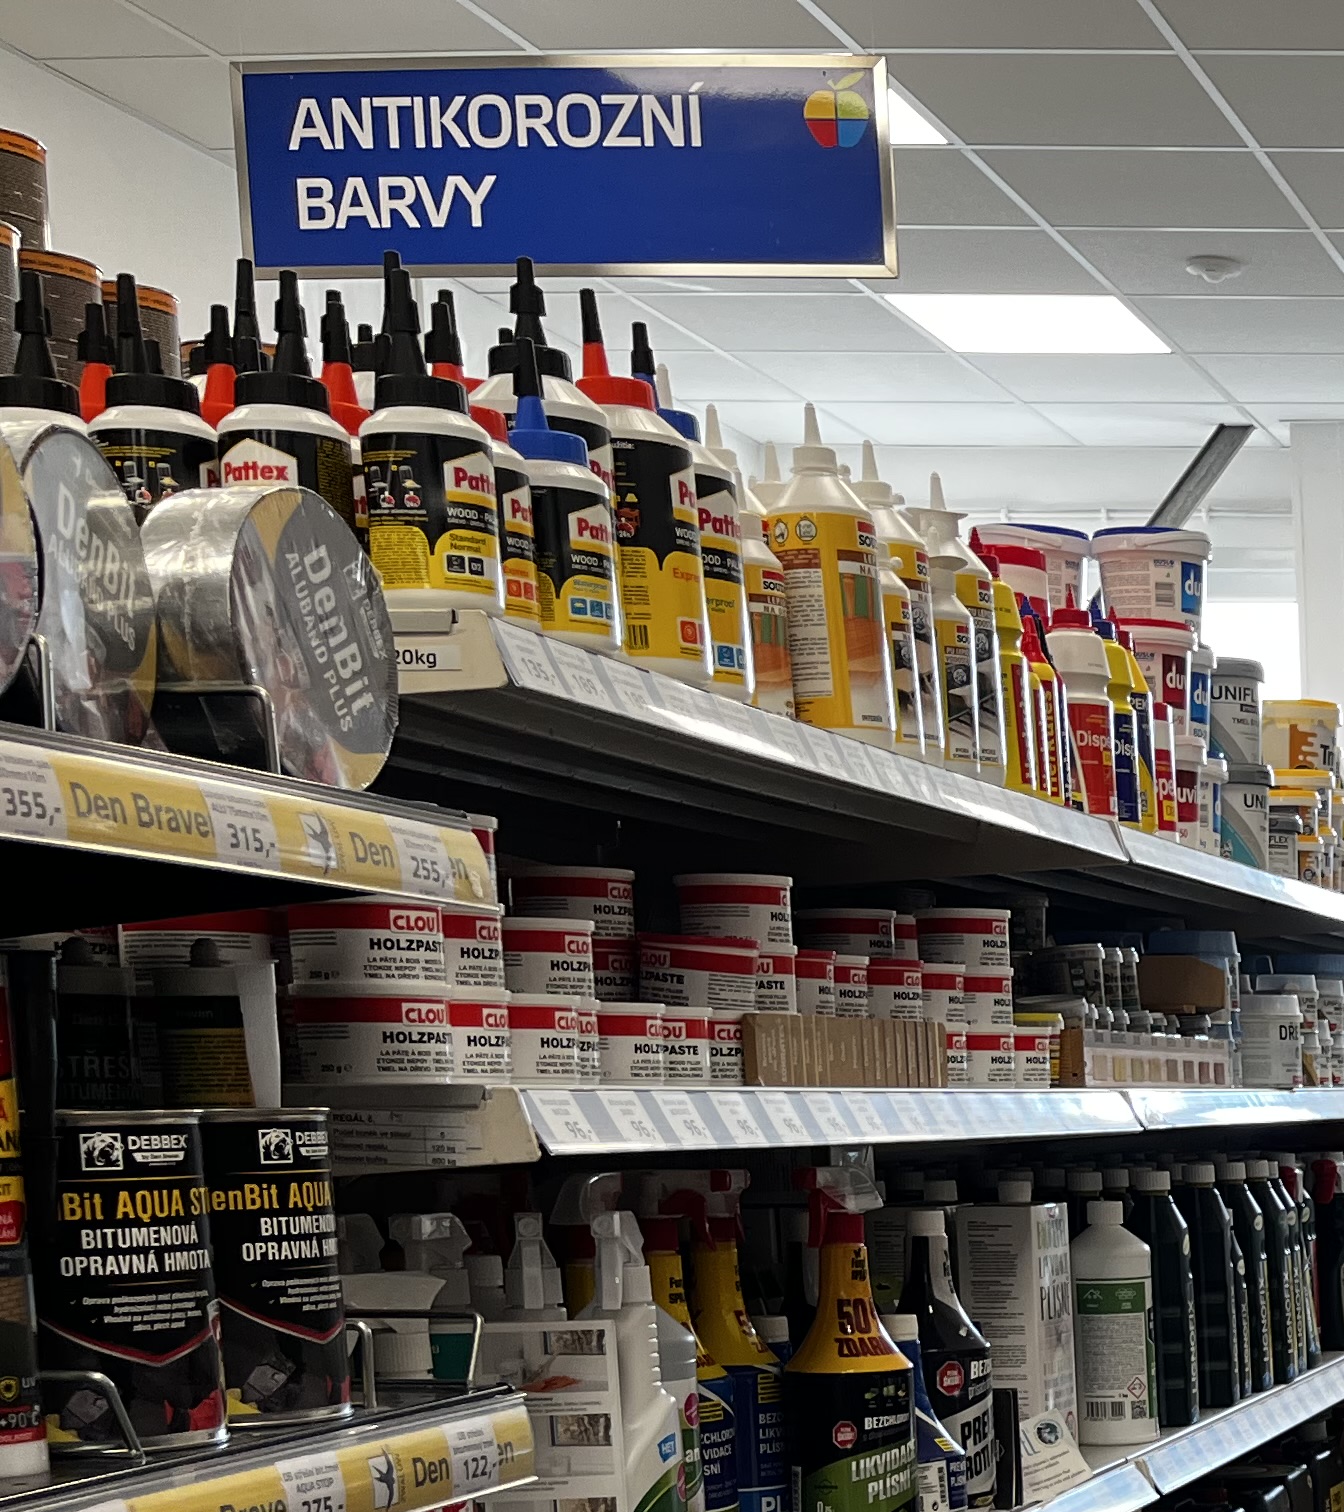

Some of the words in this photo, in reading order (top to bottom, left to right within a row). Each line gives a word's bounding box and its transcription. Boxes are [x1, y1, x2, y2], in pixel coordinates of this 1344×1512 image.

[288, 82, 704, 152] ANTIKOROZNÍ
[297, 174, 498, 231] BARVY
[223, 461, 290, 483] Pattex
[447, 508, 479, 519] WOOD
[449, 534, 487, 545] Standard
[450, 543, 481, 554] Normal
[571, 554, 599, 565] WOOD
[285, 552, 328, 664] ALUBAND
[317, 667, 353, 734] PLUS
[303, 543, 376, 716] DenBit
[5, 786, 62, 826] 355,-
[70, 781, 128, 830] Den
[137, 792, 213, 839] Brave
[229, 823, 276, 857] 315,-
[352, 831, 396, 869] Den
[411, 855, 450, 889] 255,-
[393, 914, 435, 932] CLOU
[405, 1007, 444, 1024] CLOU
[128, 1134, 188, 1150] DEBBEX
[116, 1189, 185, 1222] AQUA
[80, 1220, 199, 1250] BITUMENOVÁ
[242, 1236, 319, 1262] OPRAVNÁ
[60, 1250, 159, 1277] OPRAVNÁ
[164, 1250, 211, 1272] HMOTA
[413, 1455, 451, 1488] Den
[463, 1453, 498, 1481] 122,-
